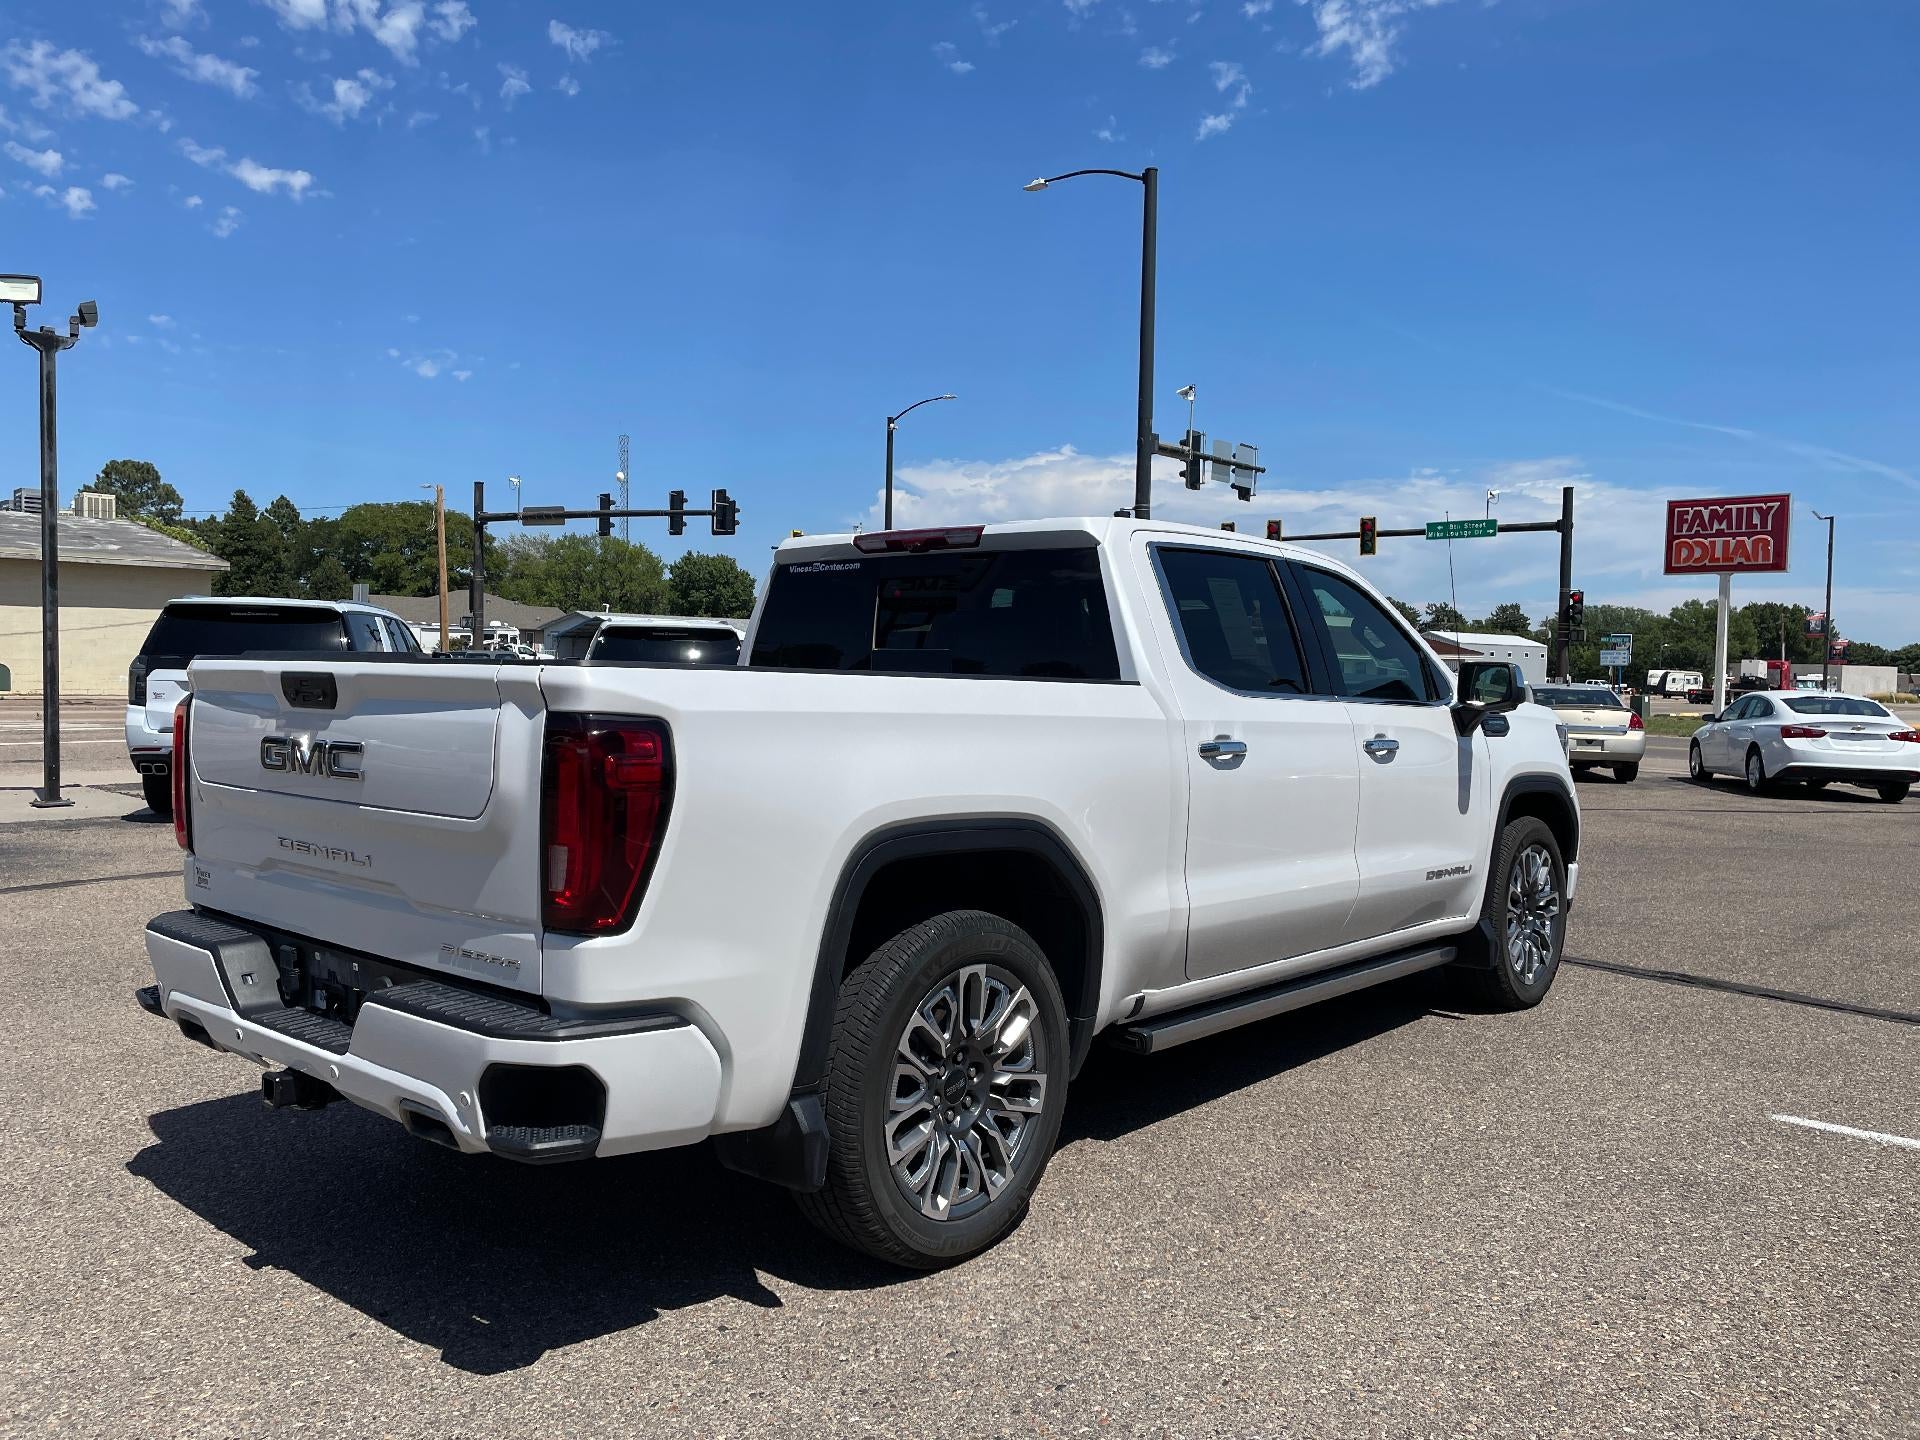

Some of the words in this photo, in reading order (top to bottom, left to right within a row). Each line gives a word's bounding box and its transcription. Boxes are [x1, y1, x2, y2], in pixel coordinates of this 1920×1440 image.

[1674, 502, 1780, 535] FAMILY
[1672, 535, 1773, 567] DOLLAR
[260, 735, 365, 782] GMC
[277, 836, 372, 868] DENALI
[1425, 864, 1473, 881] DENALI
[440, 942, 521, 969] SIERRA
